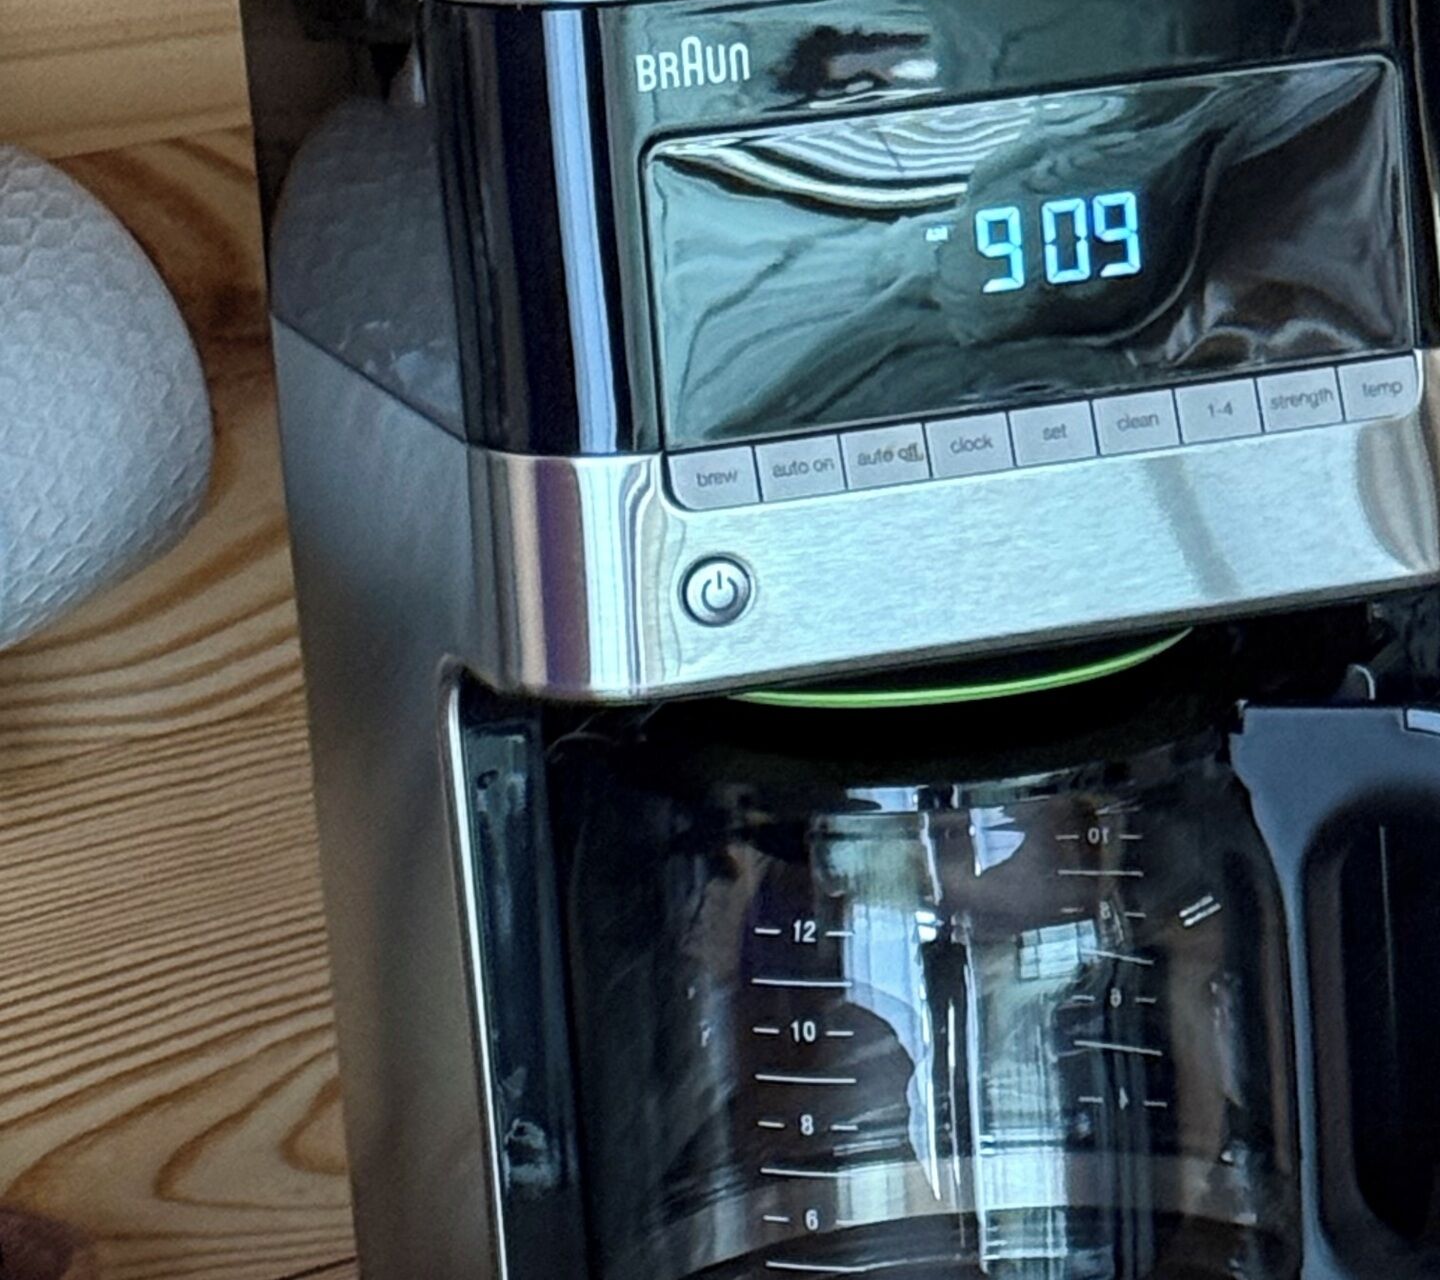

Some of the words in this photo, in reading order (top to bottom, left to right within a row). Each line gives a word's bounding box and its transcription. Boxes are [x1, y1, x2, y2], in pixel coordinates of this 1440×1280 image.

[635, 35, 750, 92] BRAUN
[1269, 387, 1334, 410] strength
[1361, 378, 1403, 399] temp
[1207, 400, 1233, 417] 1-4
[1042, 423, 1067, 440] set
[1116, 412, 1160, 432] clean
[949, 434, 994, 454] clock
[857, 447, 894, 466] auto
[696, 469, 739, 487] brew
[771, 460, 810, 478] auto
[812, 457, 835, 473] on
[792, 920, 817, 943] 12
[790, 1020, 817, 1043] 10
[799, 1114, 814, 1136] 8
[805, 1208, 819, 1231] 6
